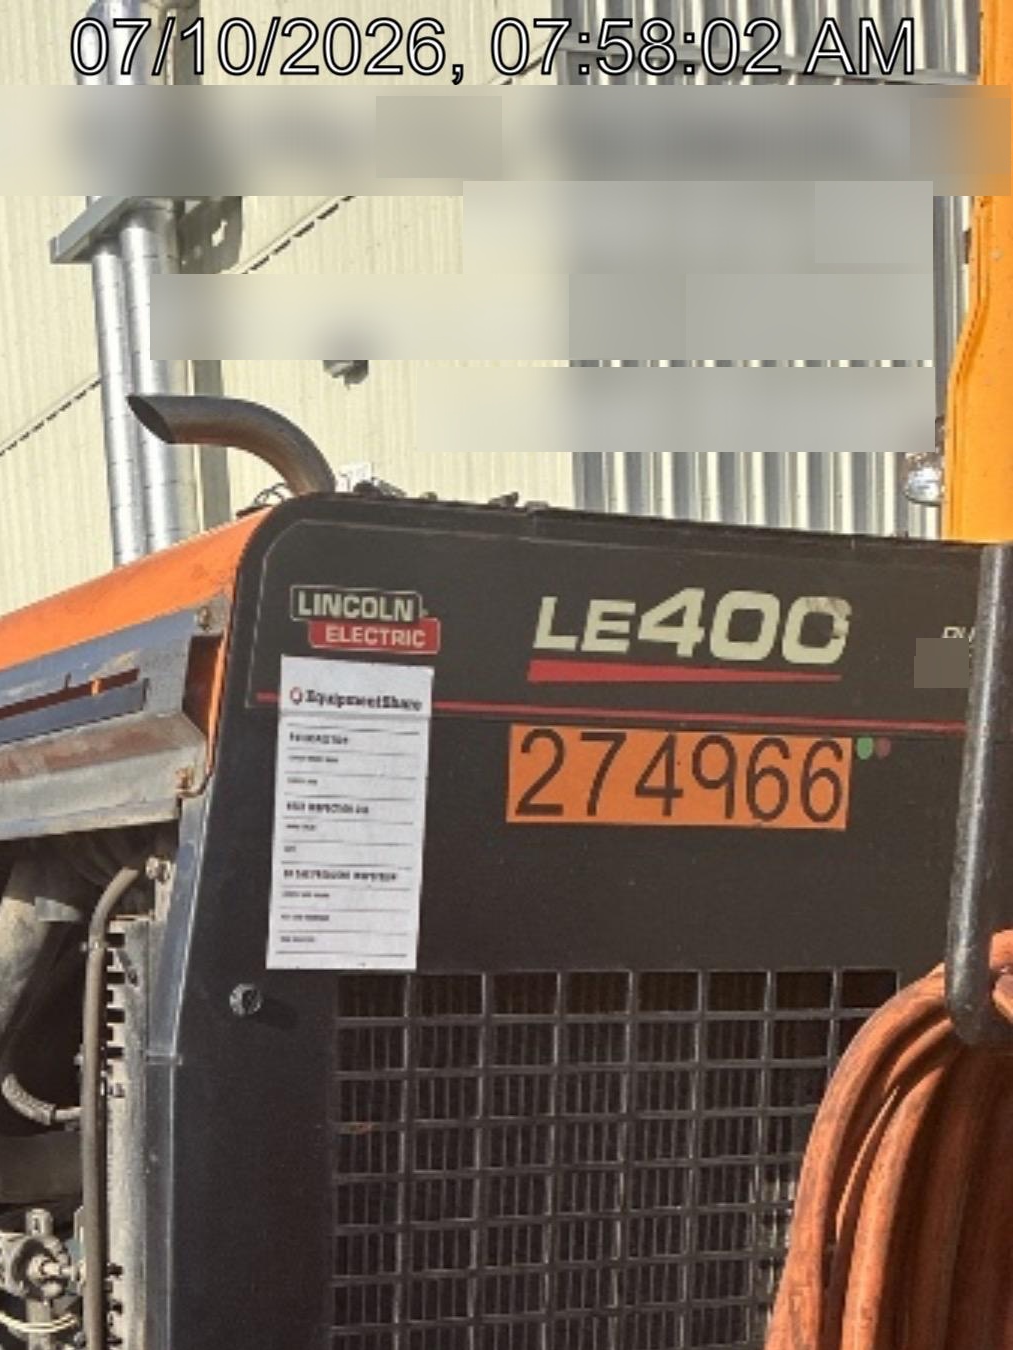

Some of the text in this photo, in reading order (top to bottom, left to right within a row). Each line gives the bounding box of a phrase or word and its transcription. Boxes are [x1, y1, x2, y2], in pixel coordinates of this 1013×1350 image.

[297, 591, 417, 623] LINCOLN
[532, 585, 853, 666] LE400
[324, 624, 427, 649] ELECTRIC
[514, 726, 845, 824] 274966
